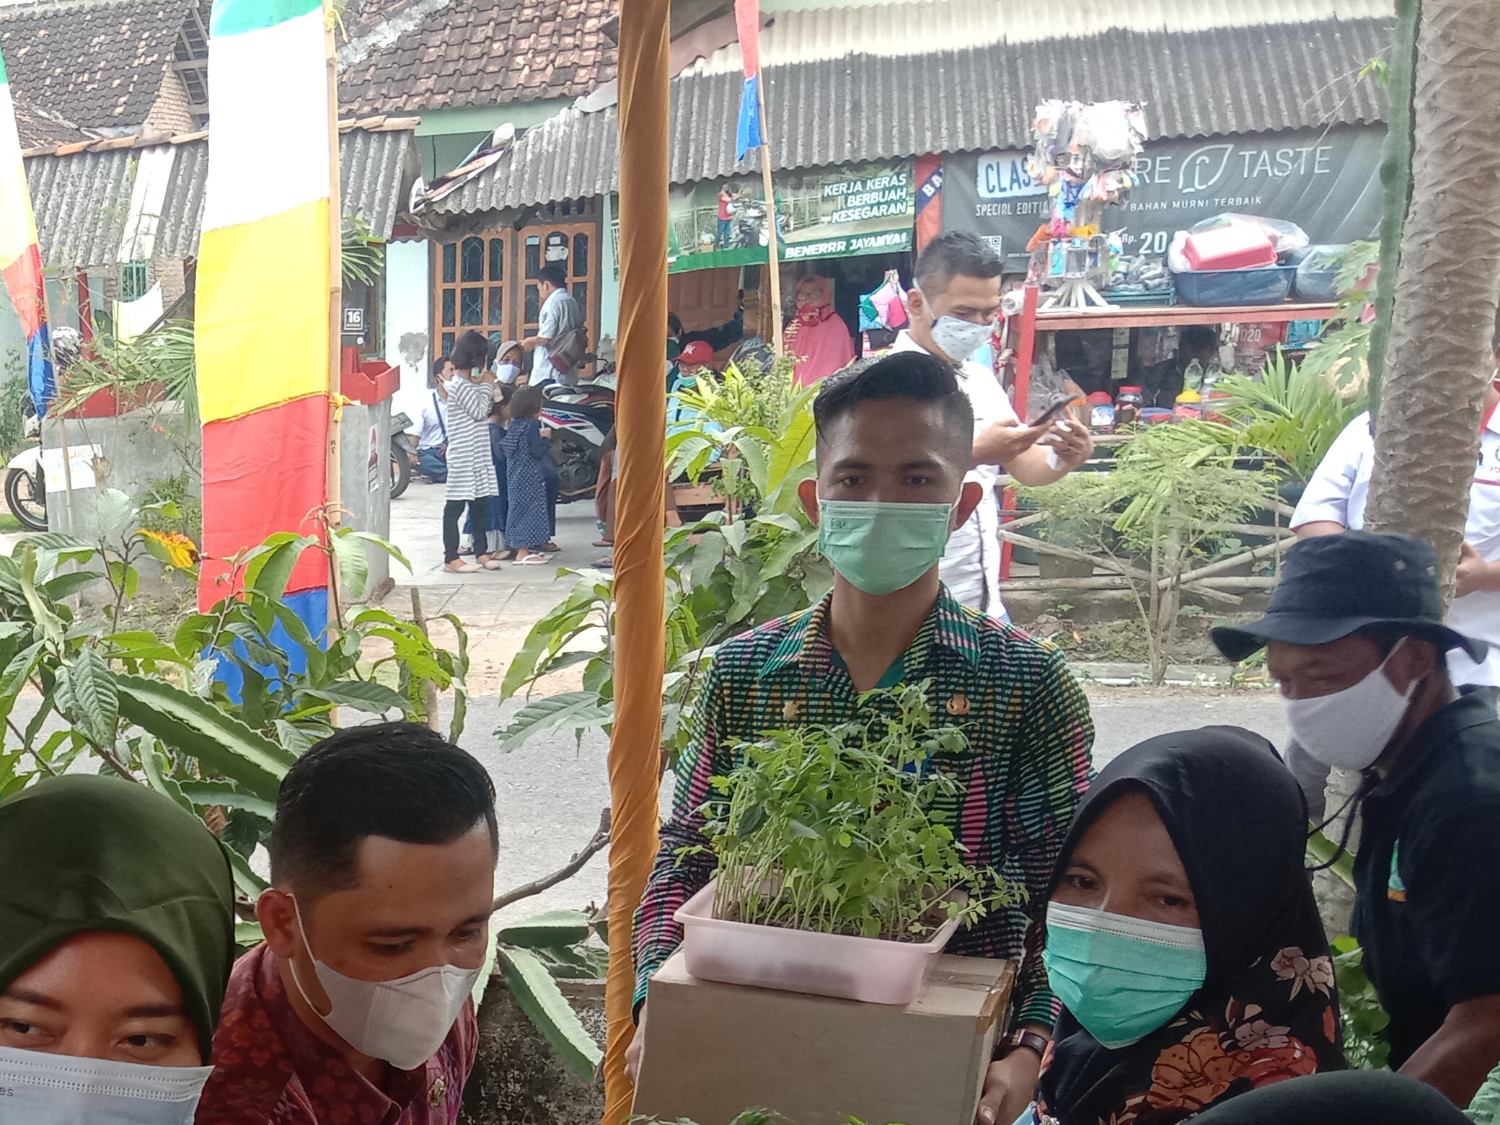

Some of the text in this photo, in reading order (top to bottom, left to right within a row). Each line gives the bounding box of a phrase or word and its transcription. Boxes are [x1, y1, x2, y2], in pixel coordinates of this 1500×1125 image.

[985, 156, 1032, 194] CLAS
[1133, 146, 1333, 184] RE TASTE
[823, 174, 907, 197] KERJA KERAS
[921, 167, 943, 197] BA
[846, 188, 908, 208] BERBUAH
[975, 201, 1050, 216] SPECIAL EDITIO
[1130, 195, 1263, 212] BAHAN MURNI TERBAIK
[831, 202, 908, 223] KESEGARAN
[785, 240, 847, 259] BENERRR
[1121, 231, 1168, 254] Rp. 20
[347, 311, 361, 323] 16
